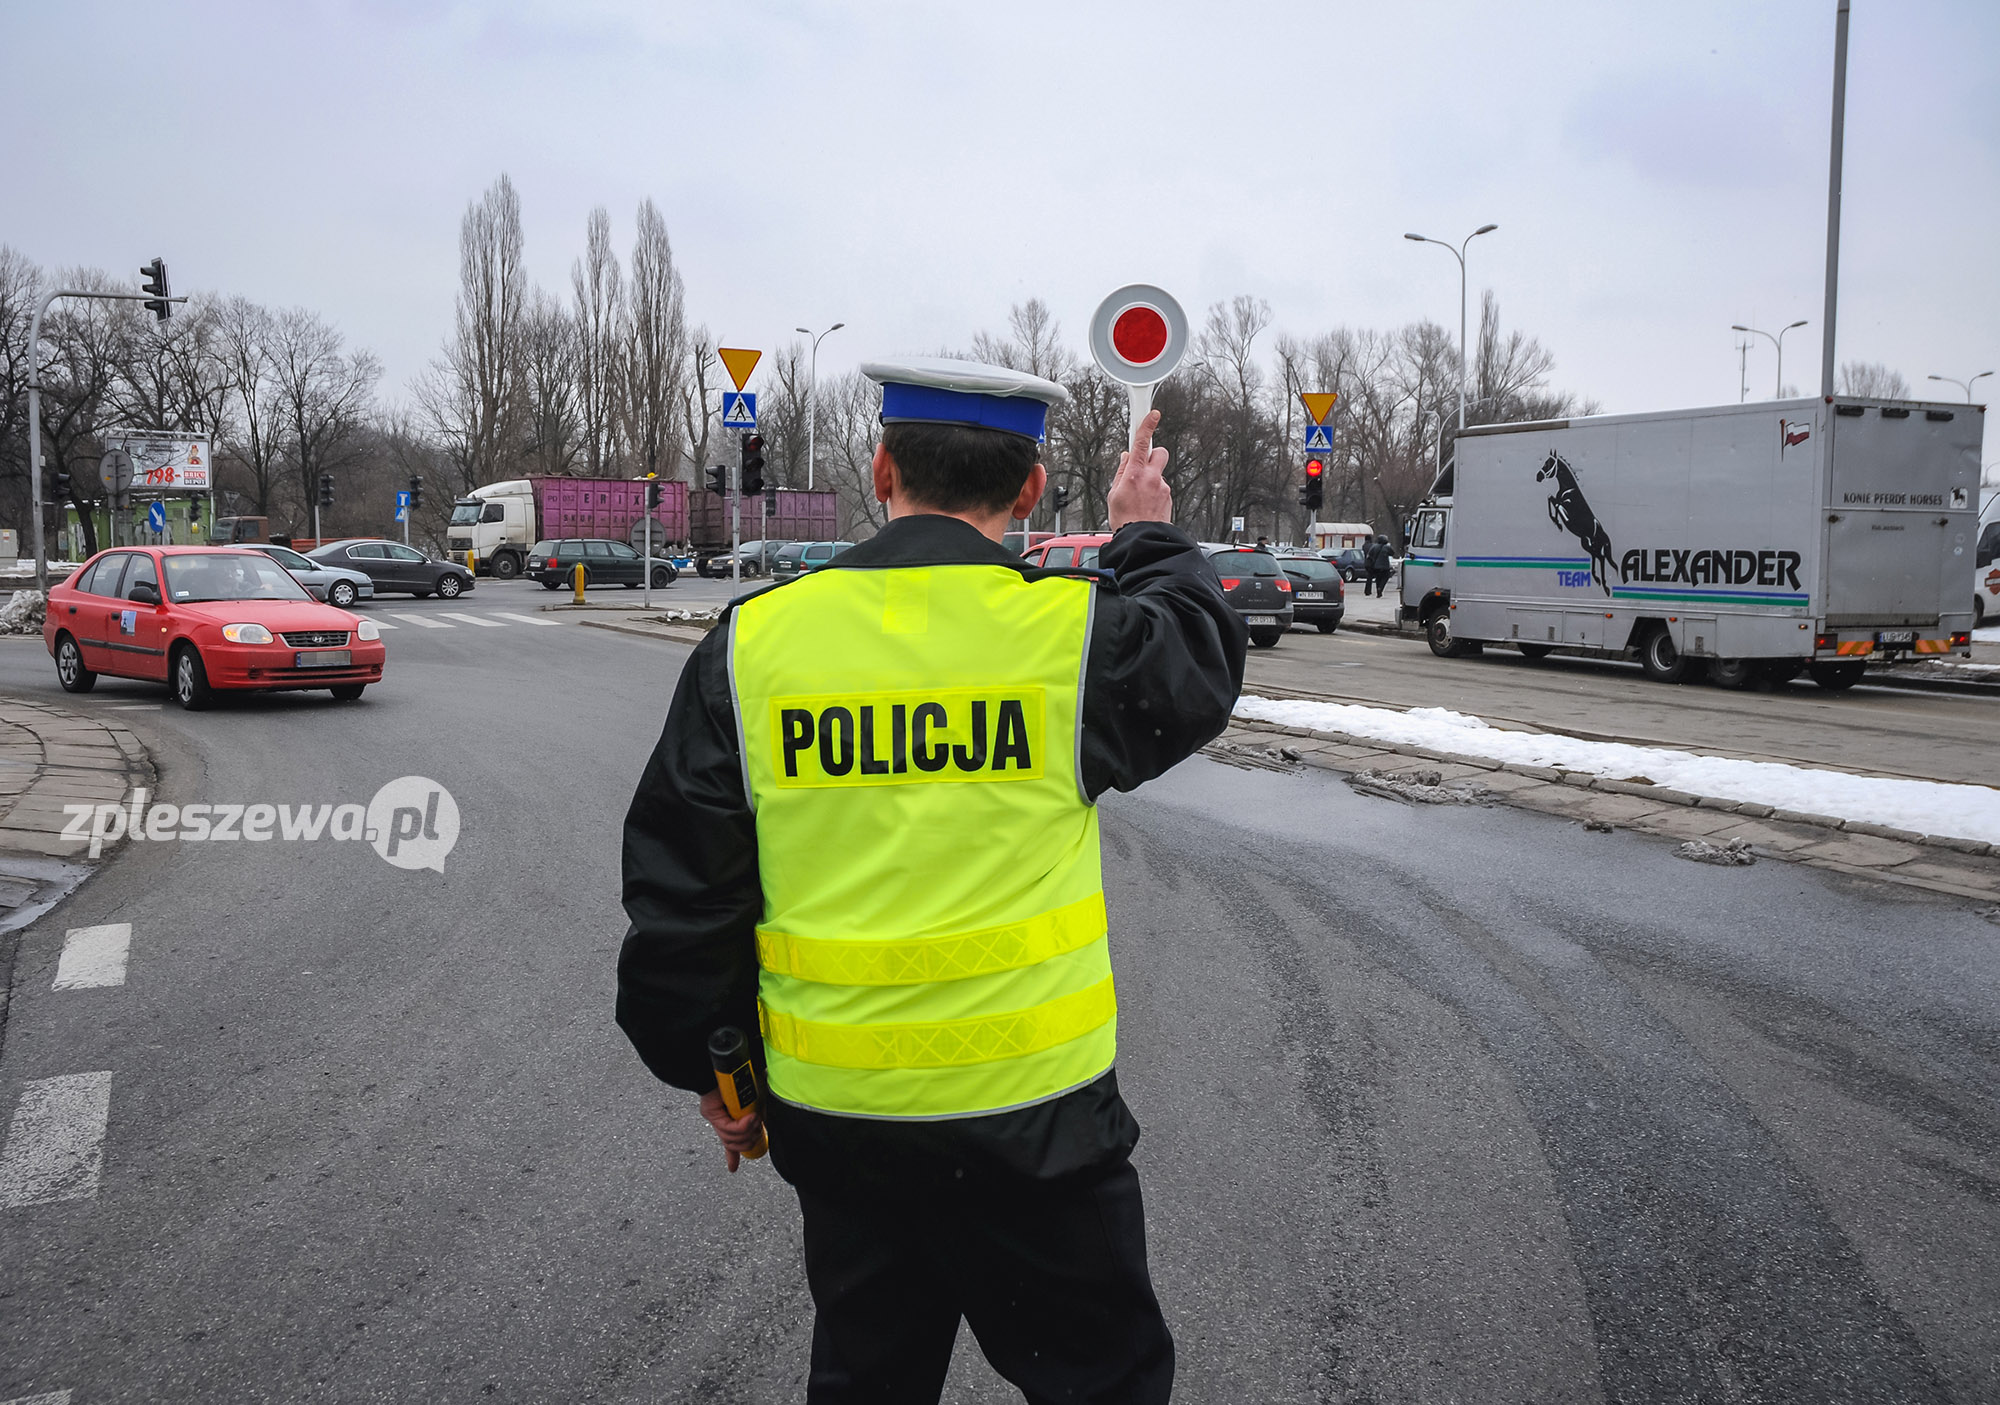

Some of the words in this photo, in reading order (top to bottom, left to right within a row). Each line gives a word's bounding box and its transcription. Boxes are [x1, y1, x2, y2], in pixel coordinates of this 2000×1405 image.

[584, 493, 640, 506] ERIX
[1843, 493, 1871, 504] KONIE
[1874, 493, 1906, 505] PFERDE
[1910, 494, 1943, 506] HORSES
[1621, 549, 1802, 591] ALEXANDER
[1557, 571, 1591, 588] TEAM
[781, 700, 1032, 777] POLICJA
